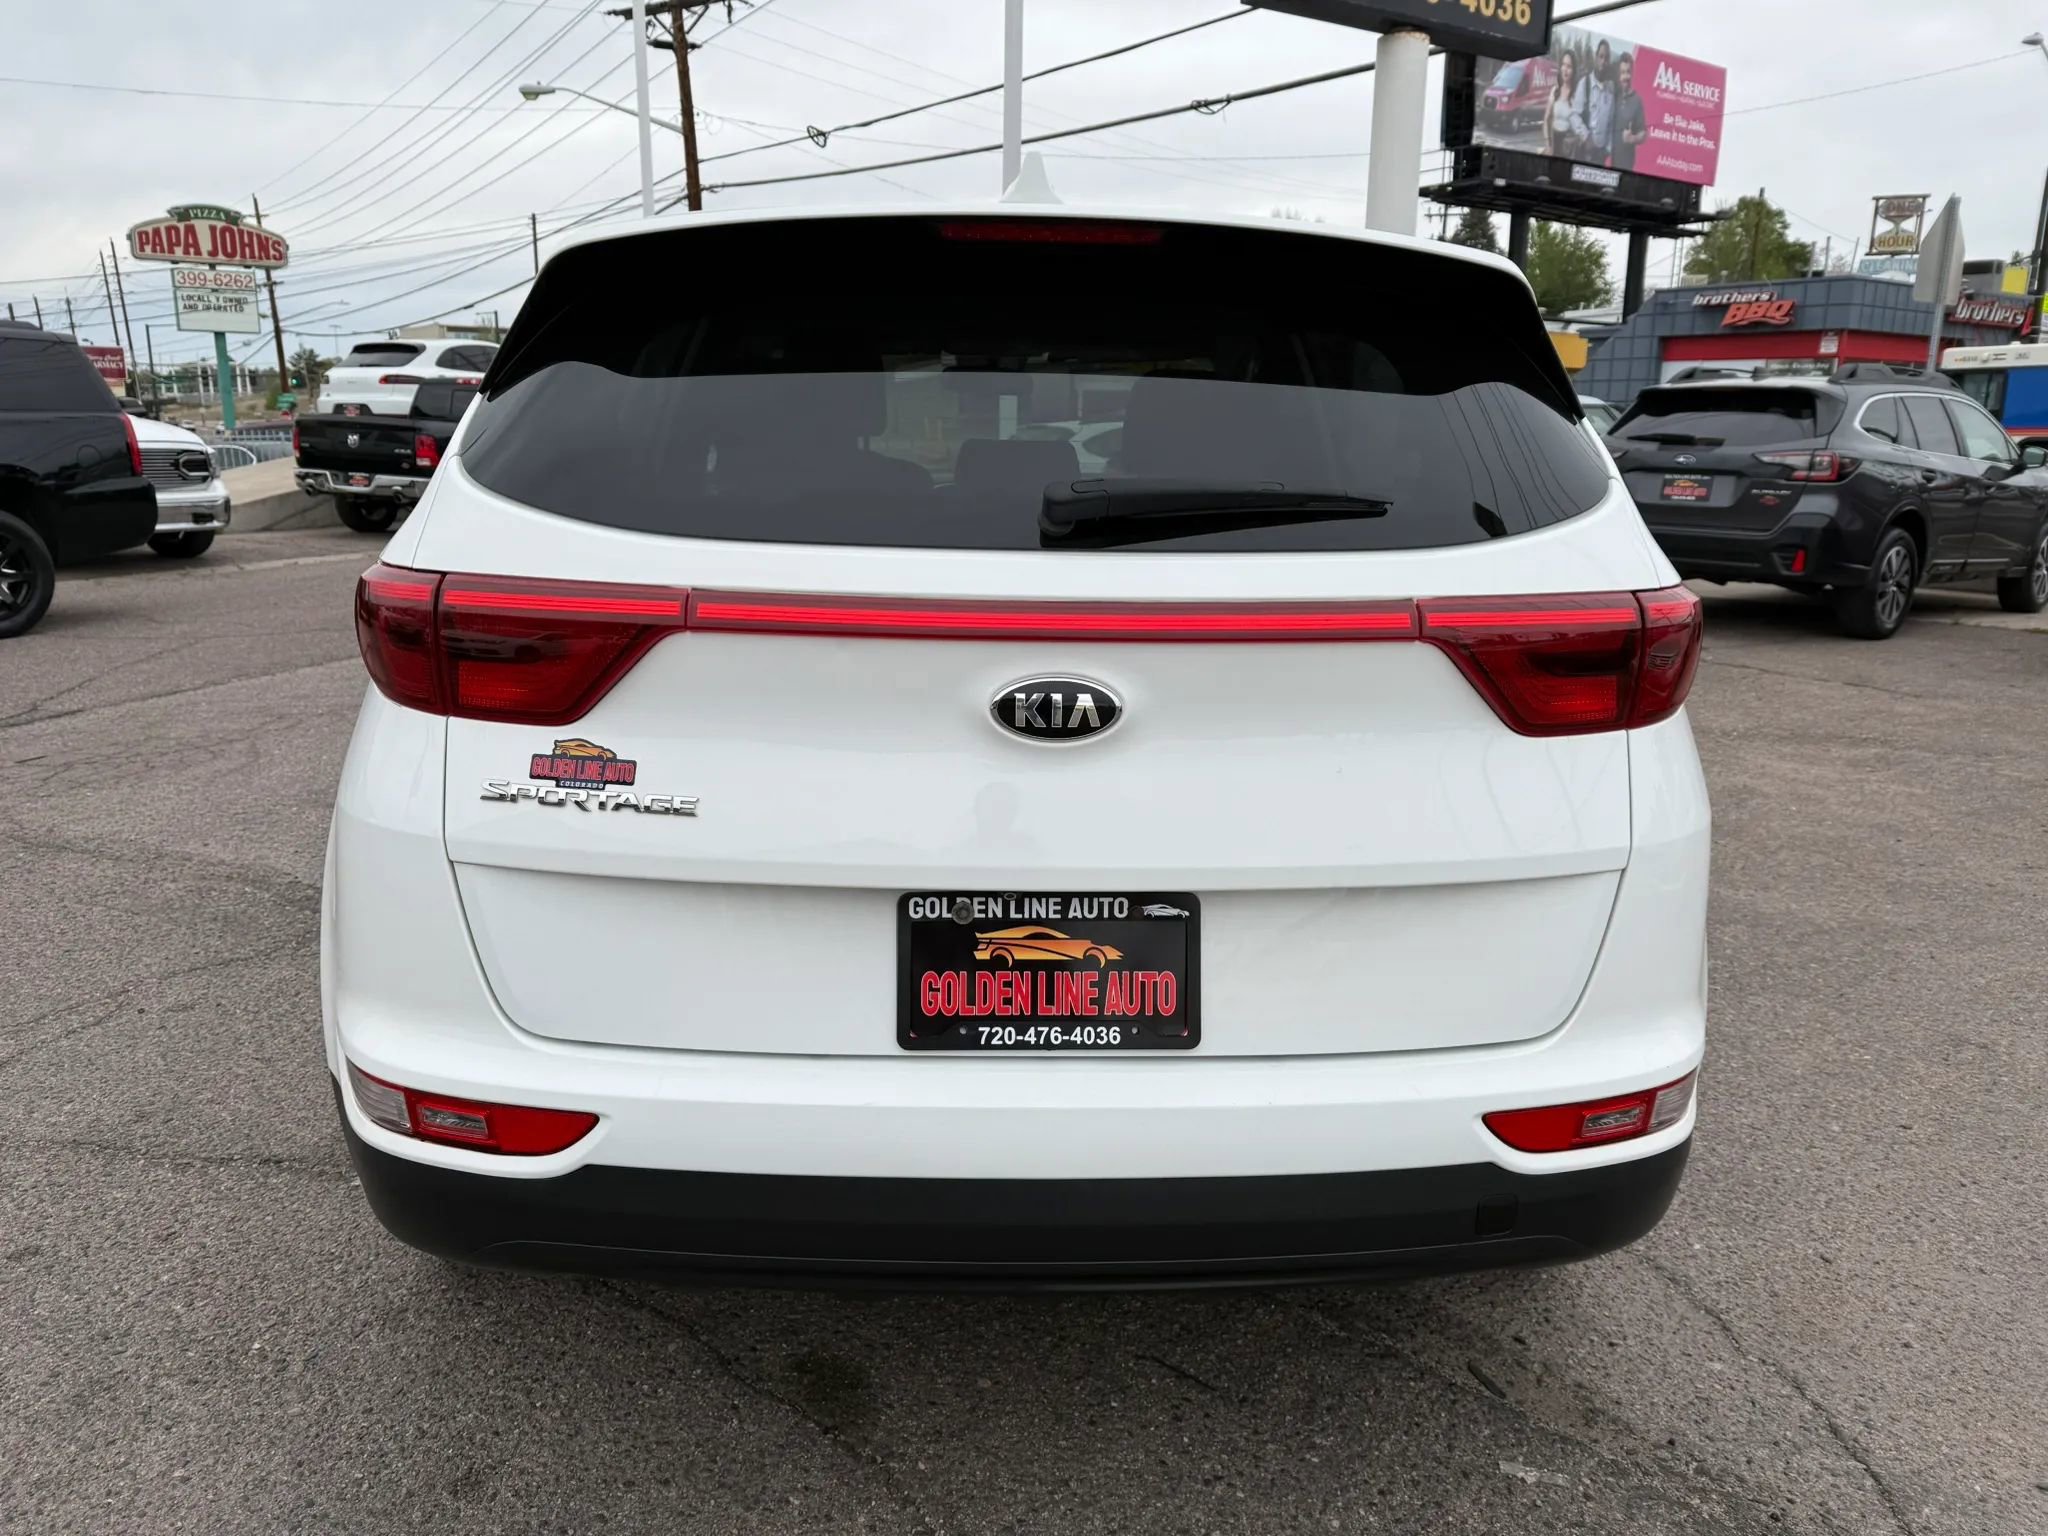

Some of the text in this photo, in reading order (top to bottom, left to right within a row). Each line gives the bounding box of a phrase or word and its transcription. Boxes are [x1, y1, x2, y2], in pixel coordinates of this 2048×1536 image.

[1653, 61, 1681, 93] AAA
[1683, 80, 1721, 102] SERVICE
[188, 208, 226, 220] PIZZA
[137, 224, 202, 256] PAPA
[1878, 235, 1915, 248] HOUR
[1861, 259, 1918, 275] CLEANIN
[176, 271, 254, 289] 399-6262
[1721, 300, 1795, 326] BBQ
[1014, 692, 1101, 728] KIA
[532, 757, 635, 783] GOLDEN LINE AUTO
[560, 780, 604, 789] COLORADO
[480, 779, 700, 817] SPORTAGE
[1009, 897, 1062, 919] LINE
[1068, 897, 1129, 919] AUTO
[921, 971, 1177, 1016] GOLDEN LINE AUTO
[978, 1026, 1122, 1045] 720-476-4036
